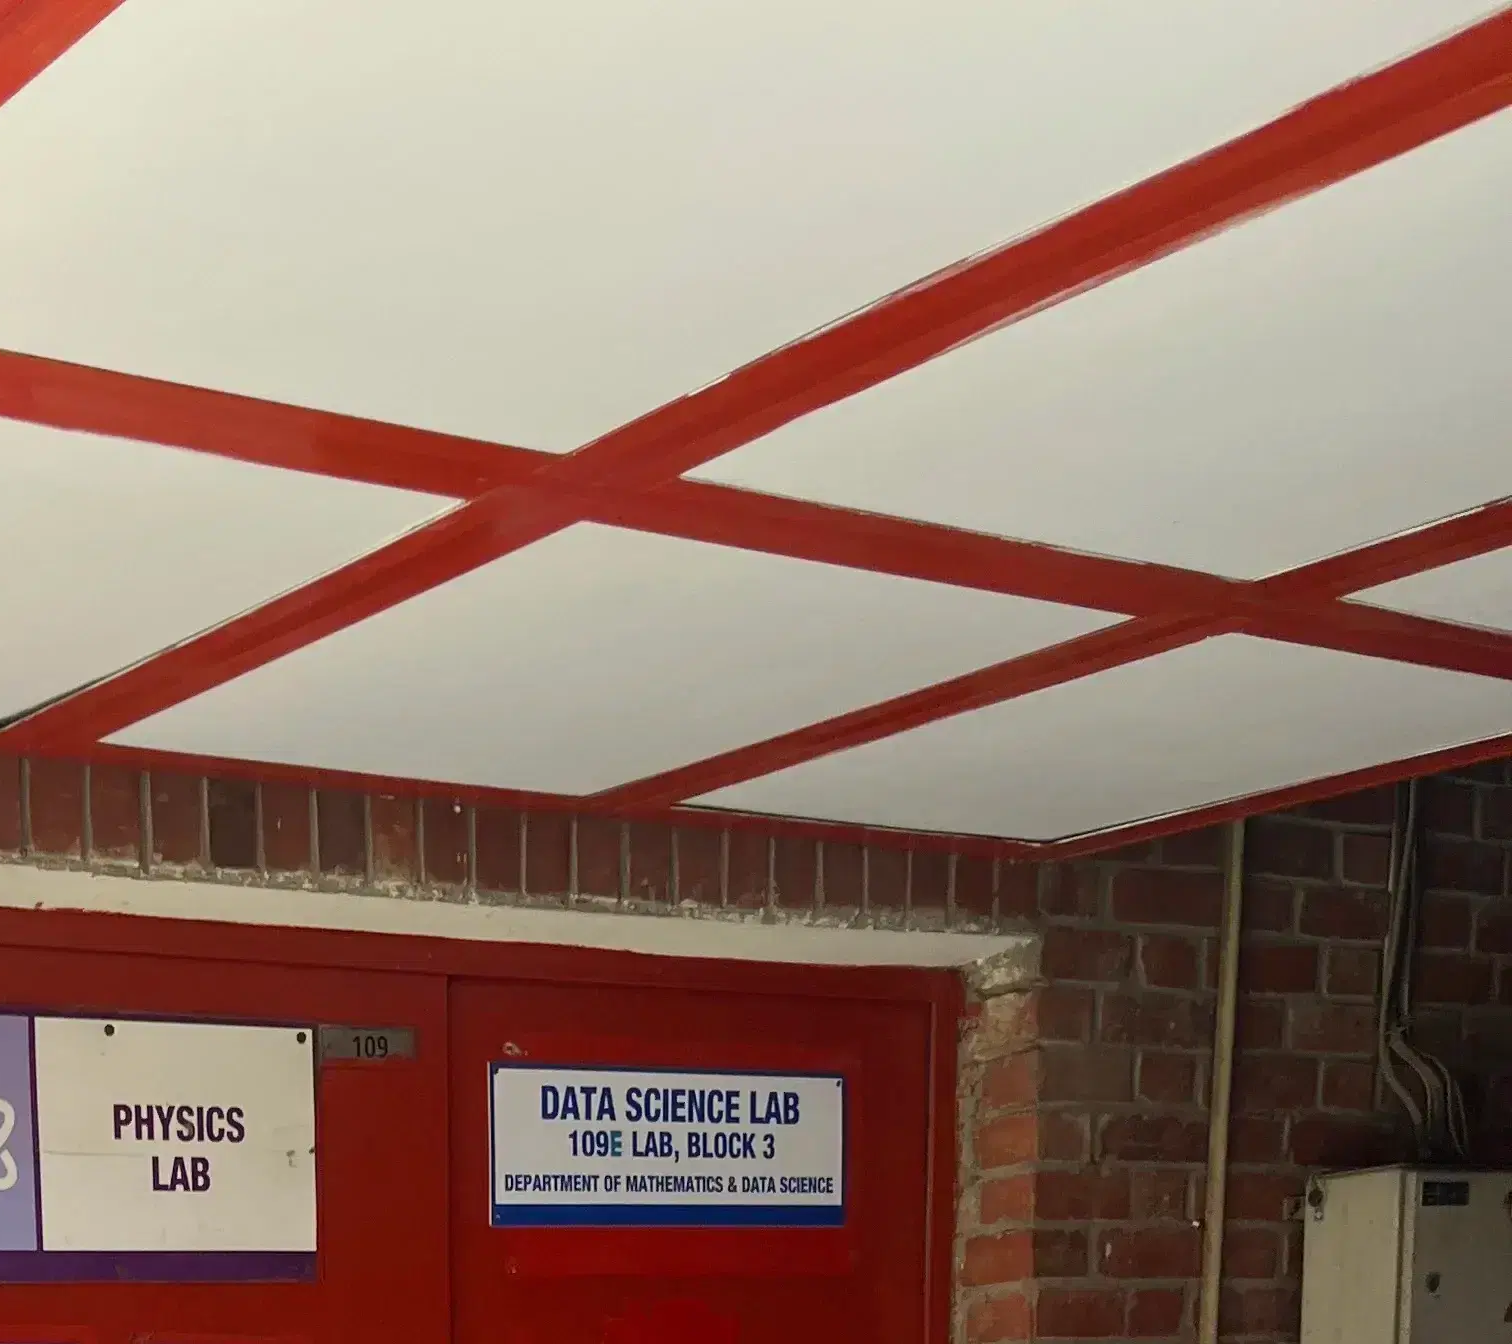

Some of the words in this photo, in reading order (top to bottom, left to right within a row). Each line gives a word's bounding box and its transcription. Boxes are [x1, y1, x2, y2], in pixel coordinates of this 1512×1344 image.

[352, 1035, 389, 1059] 109
[540, 1085, 617, 1122] DATA
[625, 1087, 741, 1124] SCIENCE
[749, 1090, 800, 1125] LAB
[113, 1103, 245, 1144] PHYSICS
[568, 1129, 623, 1157] 109E
[632, 1130, 680, 1163] LAB,
[687, 1131, 757, 1159] BLOCK
[762, 1133, 775, 1160] 3
[151, 1155, 211, 1192] LAB
[504, 1174, 600, 1193] DEPARTMENT
[603, 1174, 622, 1193] OF
[625, 1174, 724, 1194] MATHEMATICS
[727, 1175, 738, 1193] &
[741, 1175, 777, 1194] DATA
[779, 1176, 834, 1194] SCIENCE
